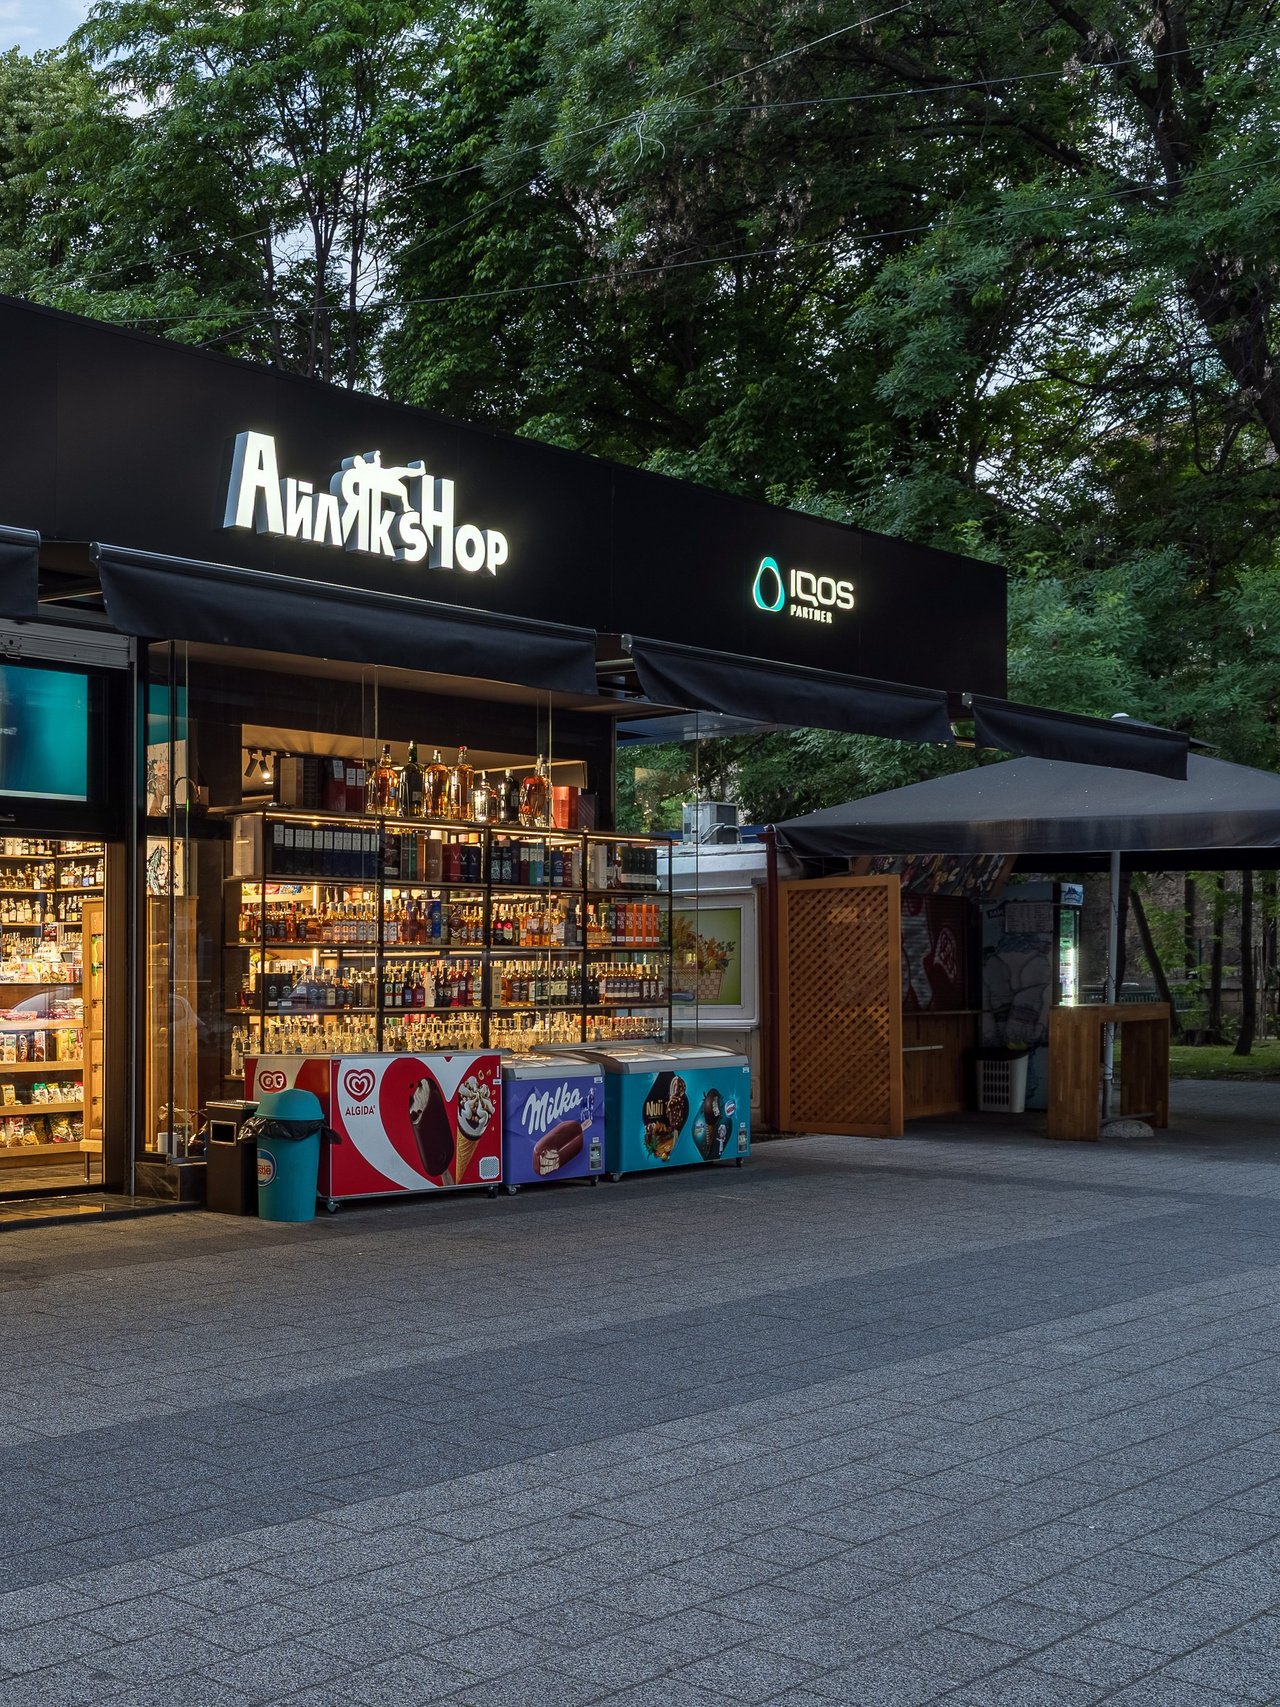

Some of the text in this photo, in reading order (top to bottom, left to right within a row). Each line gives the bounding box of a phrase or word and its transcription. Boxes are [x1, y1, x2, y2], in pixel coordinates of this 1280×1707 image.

[790, 569, 854, 609] IQOS
[790, 604, 833, 624] PARTNER
[345, 1106, 375, 1116] ALGIDA
[521, 1082, 583, 1135] Milka
